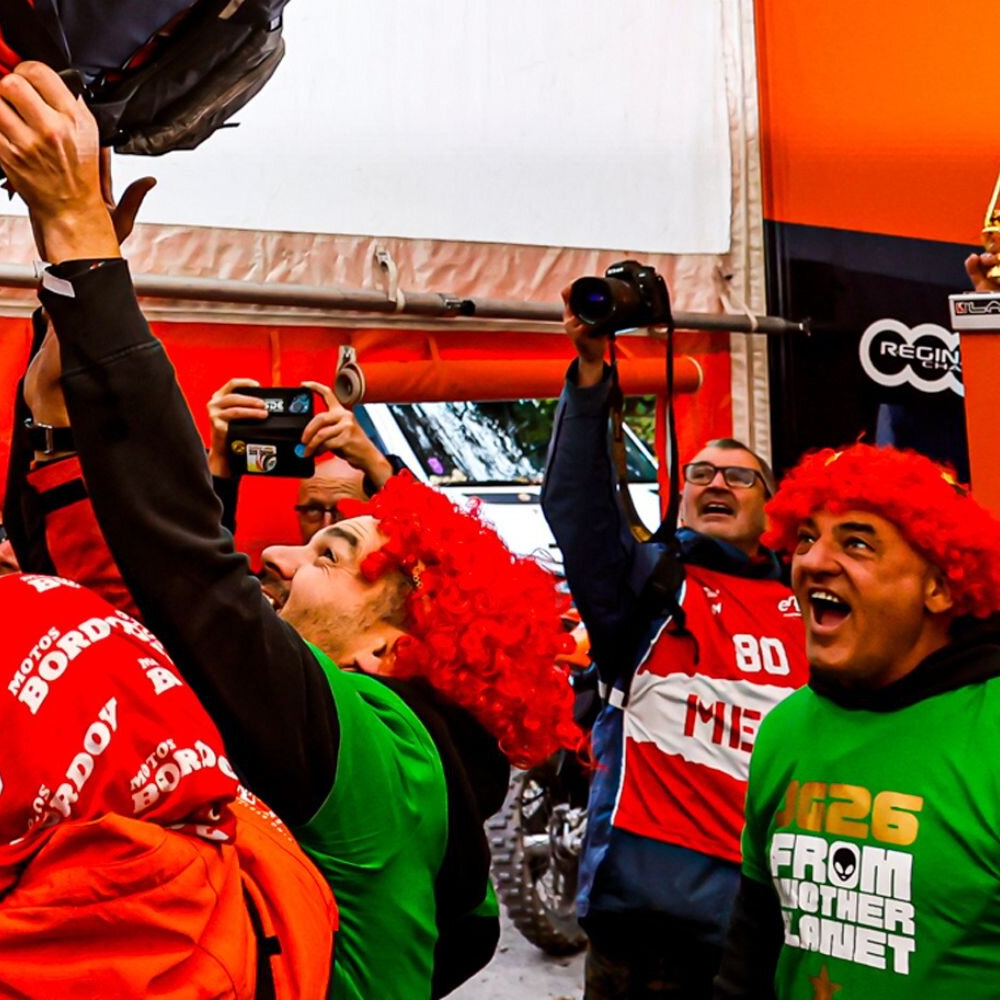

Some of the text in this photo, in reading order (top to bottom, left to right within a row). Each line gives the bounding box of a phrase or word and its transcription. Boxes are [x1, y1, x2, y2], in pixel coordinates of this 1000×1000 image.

[879, 340, 962, 366] REGIN
[921, 360, 963, 373] CHA
[7, 626, 61, 696] MOTOS
[732, 633, 791, 677] 80
[683, 693, 761, 754] ME
[42, 696, 118, 825] RDOY
[130, 738, 177, 791] MOTOS
[131, 740, 239, 814] BORDO
[775, 779, 924, 846] JG26
[769, 832, 914, 901] FROM
[773, 877, 916, 936] NOTHER
[782, 910, 916, 976] LANET
